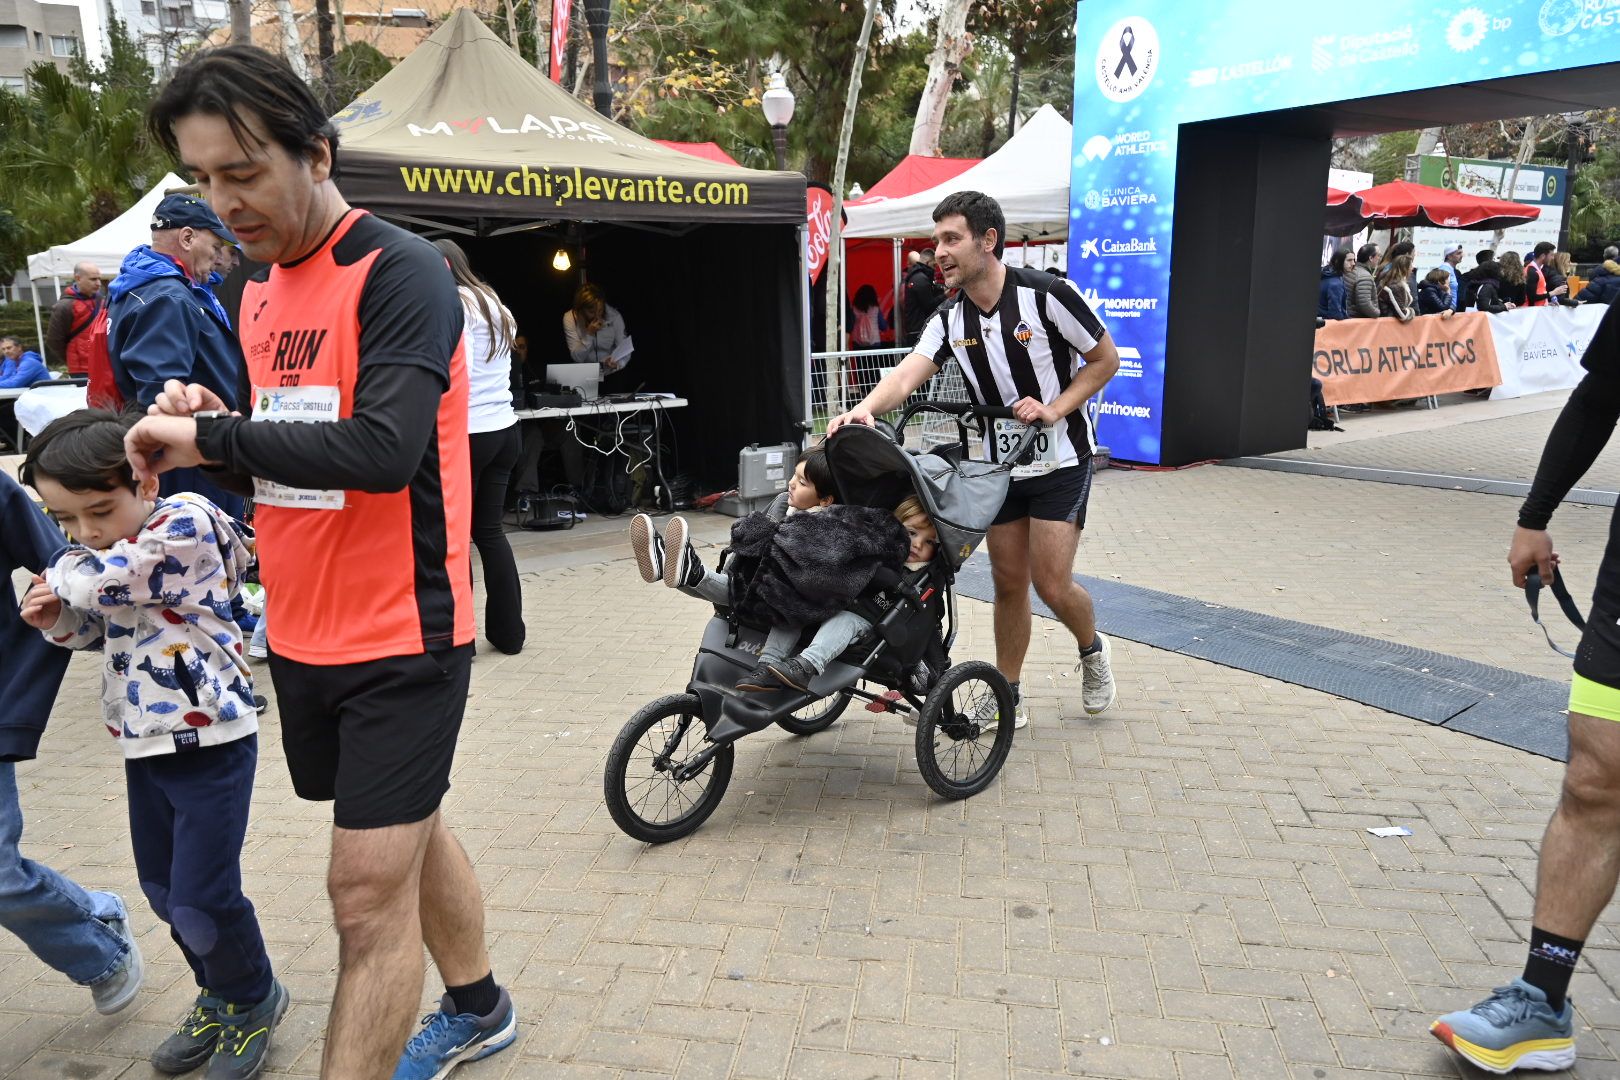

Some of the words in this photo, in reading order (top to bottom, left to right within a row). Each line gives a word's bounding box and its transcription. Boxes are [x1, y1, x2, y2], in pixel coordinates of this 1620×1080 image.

[1493, 17, 1511, 31] bp
[407, 113, 614, 142] MYLAPS
[1115, 132, 1150, 144] WORLD
[1115, 142, 1167, 156] ATHLETICS
[400, 164, 749, 207] www.chiplevante.com
[1102, 187, 1140, 196] CLINICA
[1102, 195, 1156, 207] BAVIERA
[1101, 237, 1157, 253] CaixaBank
[1105, 298, 1157, 309] MONFORT
[272, 329, 327, 372] RUN
[1312, 346, 1372, 376] ORLD
[1378, 338, 1477, 374] ATHLETICS
[1523, 347, 1558, 361] BAVIERA
[999, 432, 1048, 454] 320
